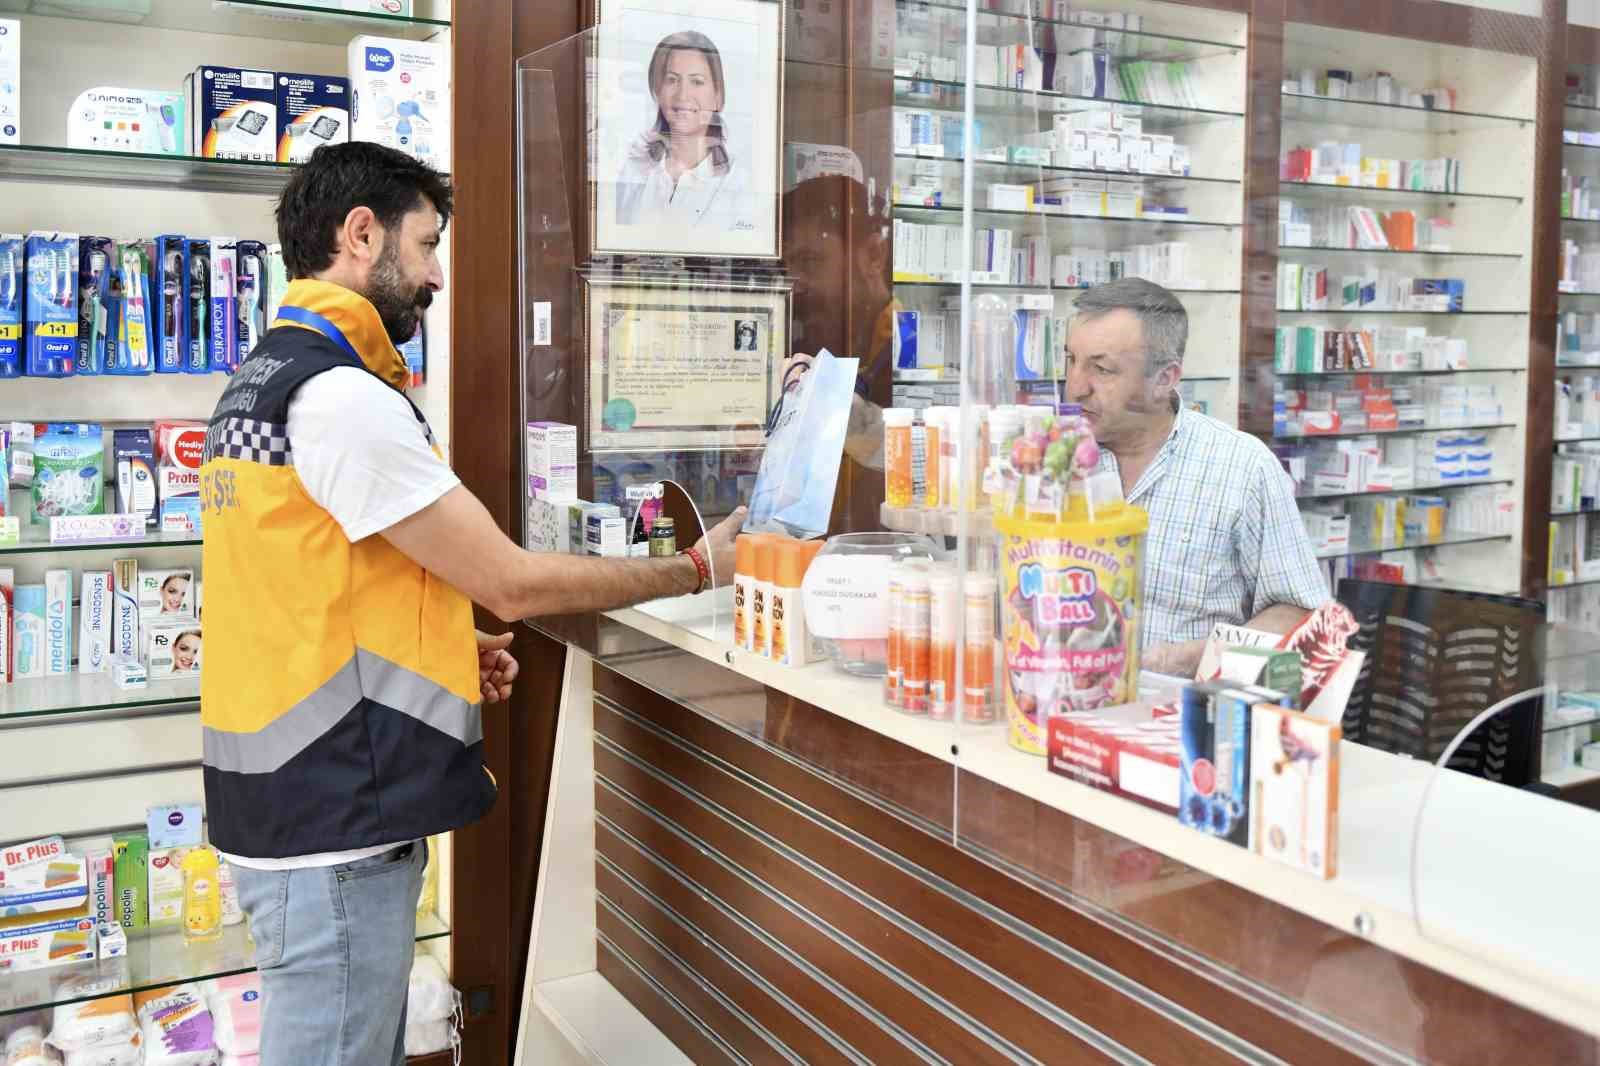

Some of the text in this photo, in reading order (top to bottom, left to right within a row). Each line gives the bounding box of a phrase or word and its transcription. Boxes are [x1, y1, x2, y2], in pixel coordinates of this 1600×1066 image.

[214, 303, 225, 362] CURAPROX
[178, 440, 204, 450] Hediy
[168, 471, 199, 483] Prote
[92, 576, 104, 631] SENSODYNE
[1038, 597, 1095, 624] BALL
[48, 615, 64, 672] meridol
[5, 842, 60, 866] Dr. Plus
[11, 938, 39, 953] Plus
